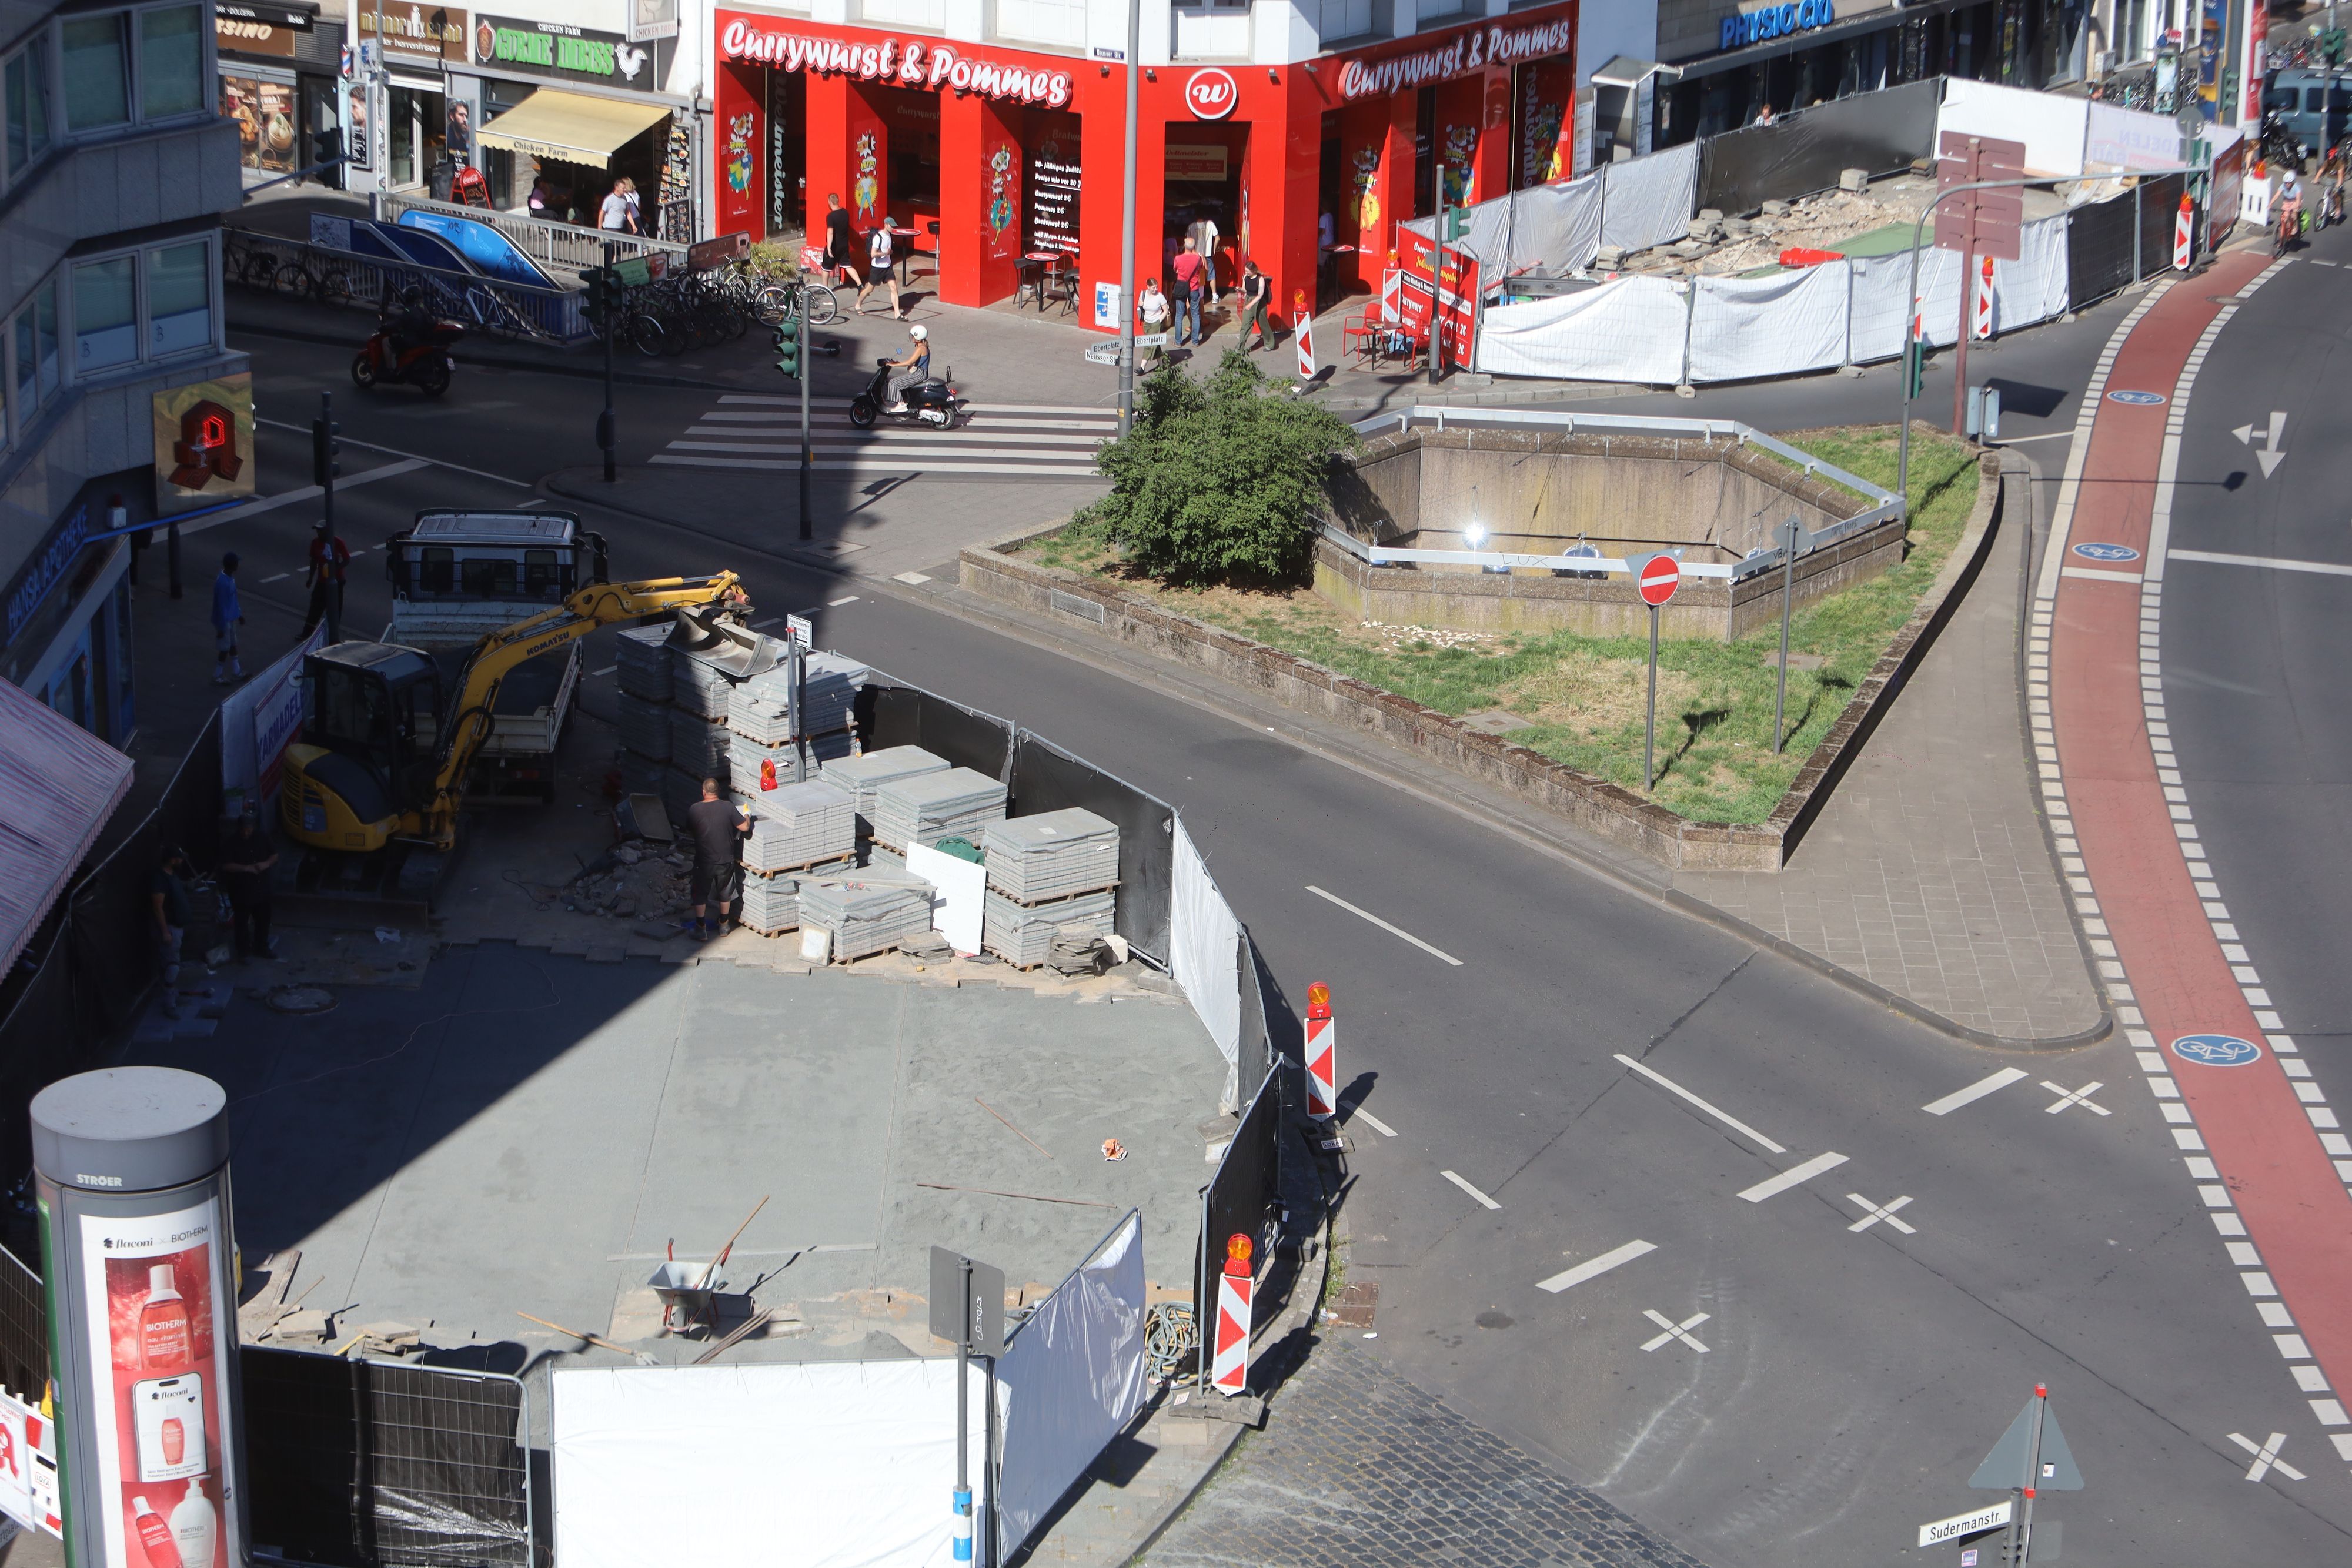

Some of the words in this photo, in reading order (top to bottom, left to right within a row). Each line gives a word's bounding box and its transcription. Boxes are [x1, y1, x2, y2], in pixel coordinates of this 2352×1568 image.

[537, 22, 564, 35] CHICKEN
[564, 25, 582, 36] FARM
[635, 26, 660, 39] CHICKEN
[660, 24, 677, 36] FARM
[1722, 4, 1795, 49] PHYSIO
[1799, 0, 1832, 29] CKI
[556, 36, 616, 76] IMBISS
[1344, 35, 1465, 100] Currywurst
[1468, 29, 1484, 68] &
[1486, 18, 1570, 63] Pommes
[722, 19, 893, 79] Currywurst
[898, 42, 925, 82] &
[928, 45, 1069, 108] Pommes
[513, 141, 544, 153] Chicken
[548, 147, 569, 158] Farm
[1035, 189, 1063, 201] Currywurst
[1034, 203, 1056, 213] Pommes
[1034, 216, 1060, 228] Bratwurst
[1094, 341, 1120, 352] Ebertplatz
[1137, 336, 1164, 346] Ebertplatz
[1087, 351, 1108, 363] Neusser
[1502, 554, 1549, 567] LUX
[7, 567, 41, 634] HANSA
[42, 503, 88, 587] APOTHEKE
[526, 631, 570, 656] KOMATSU
[77, 1174, 123, 1187] STRÖER
[116, 1237, 153, 1249] flaconi
[171, 1225, 209, 1243] BIOTHERM
[146, 1318, 187, 1332] BIOTHERM
[161, 1388, 188, 1400] flaconi
[36, 1473, 50, 1486] LOKA
[142, 1523, 165, 1534] BIOTHERM
[1930, 1510, 2001, 1541] Sudermanstr.
